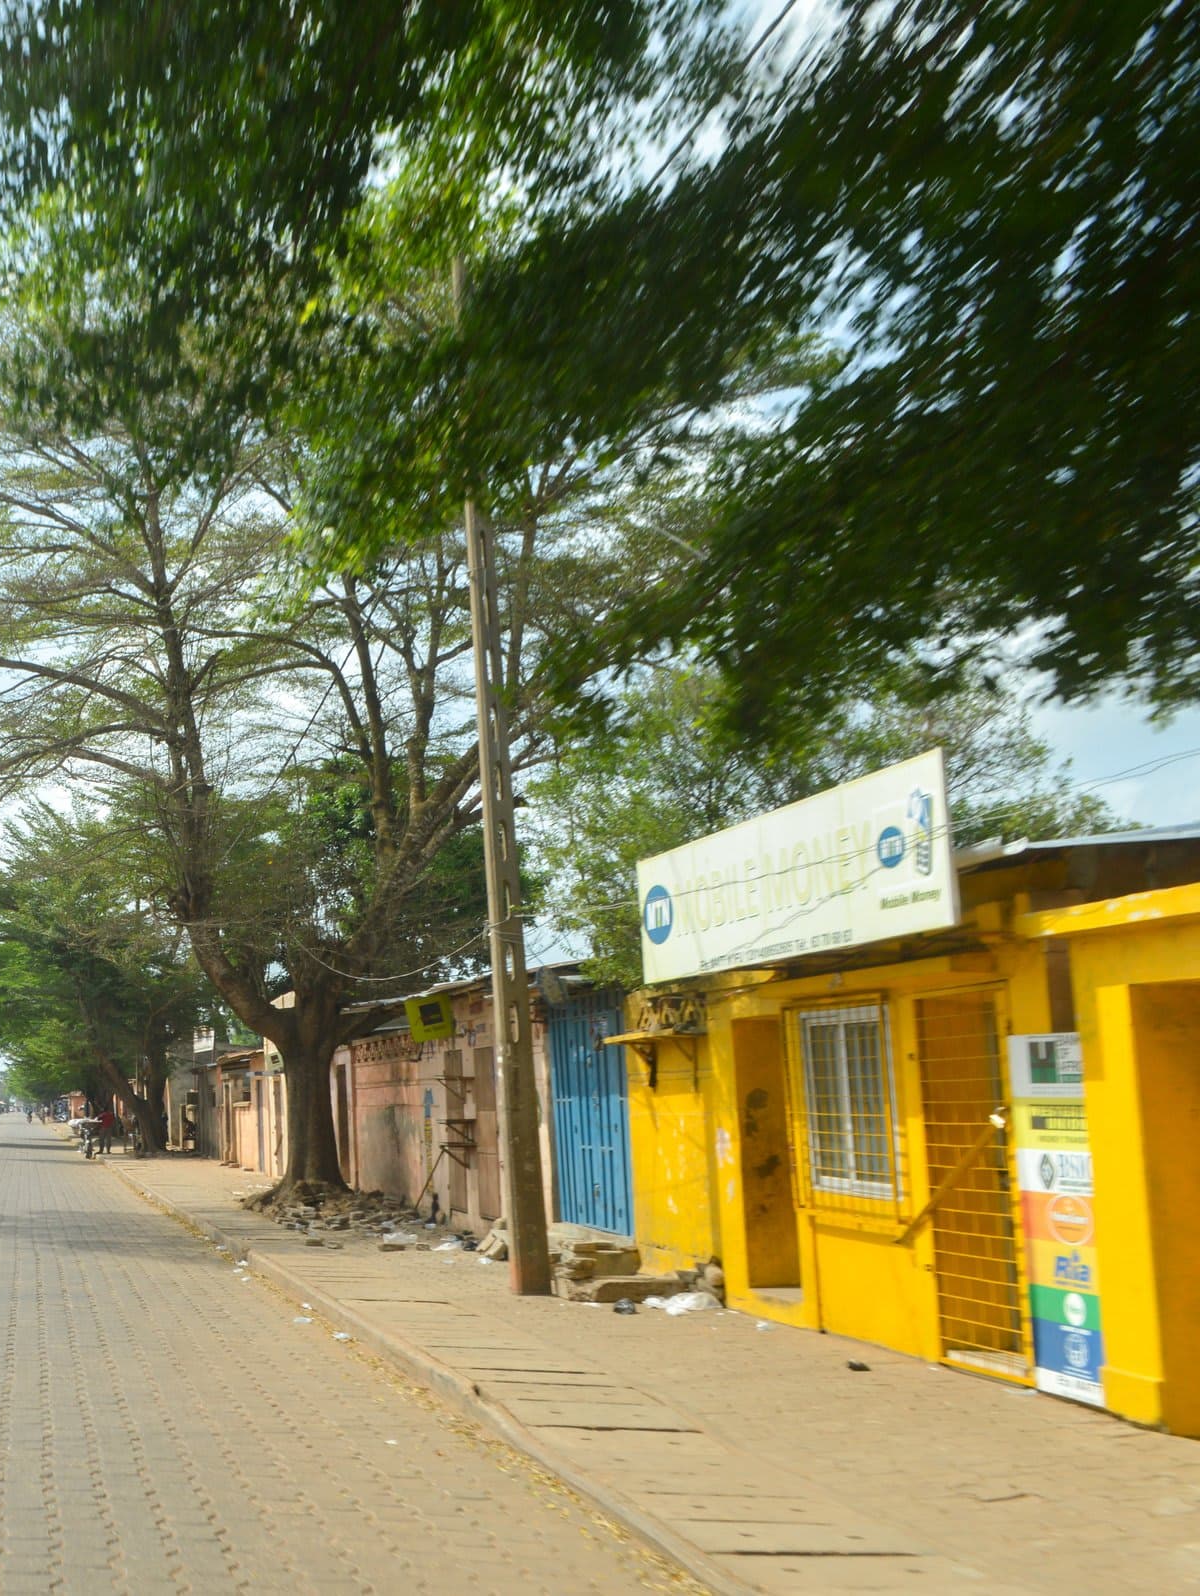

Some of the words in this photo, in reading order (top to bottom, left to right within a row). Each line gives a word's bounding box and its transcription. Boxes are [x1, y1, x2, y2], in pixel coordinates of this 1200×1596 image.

[646, 897, 672, 932] MTN
[675, 858, 761, 937] MOBILE
[767, 821, 872, 912] MONEY
